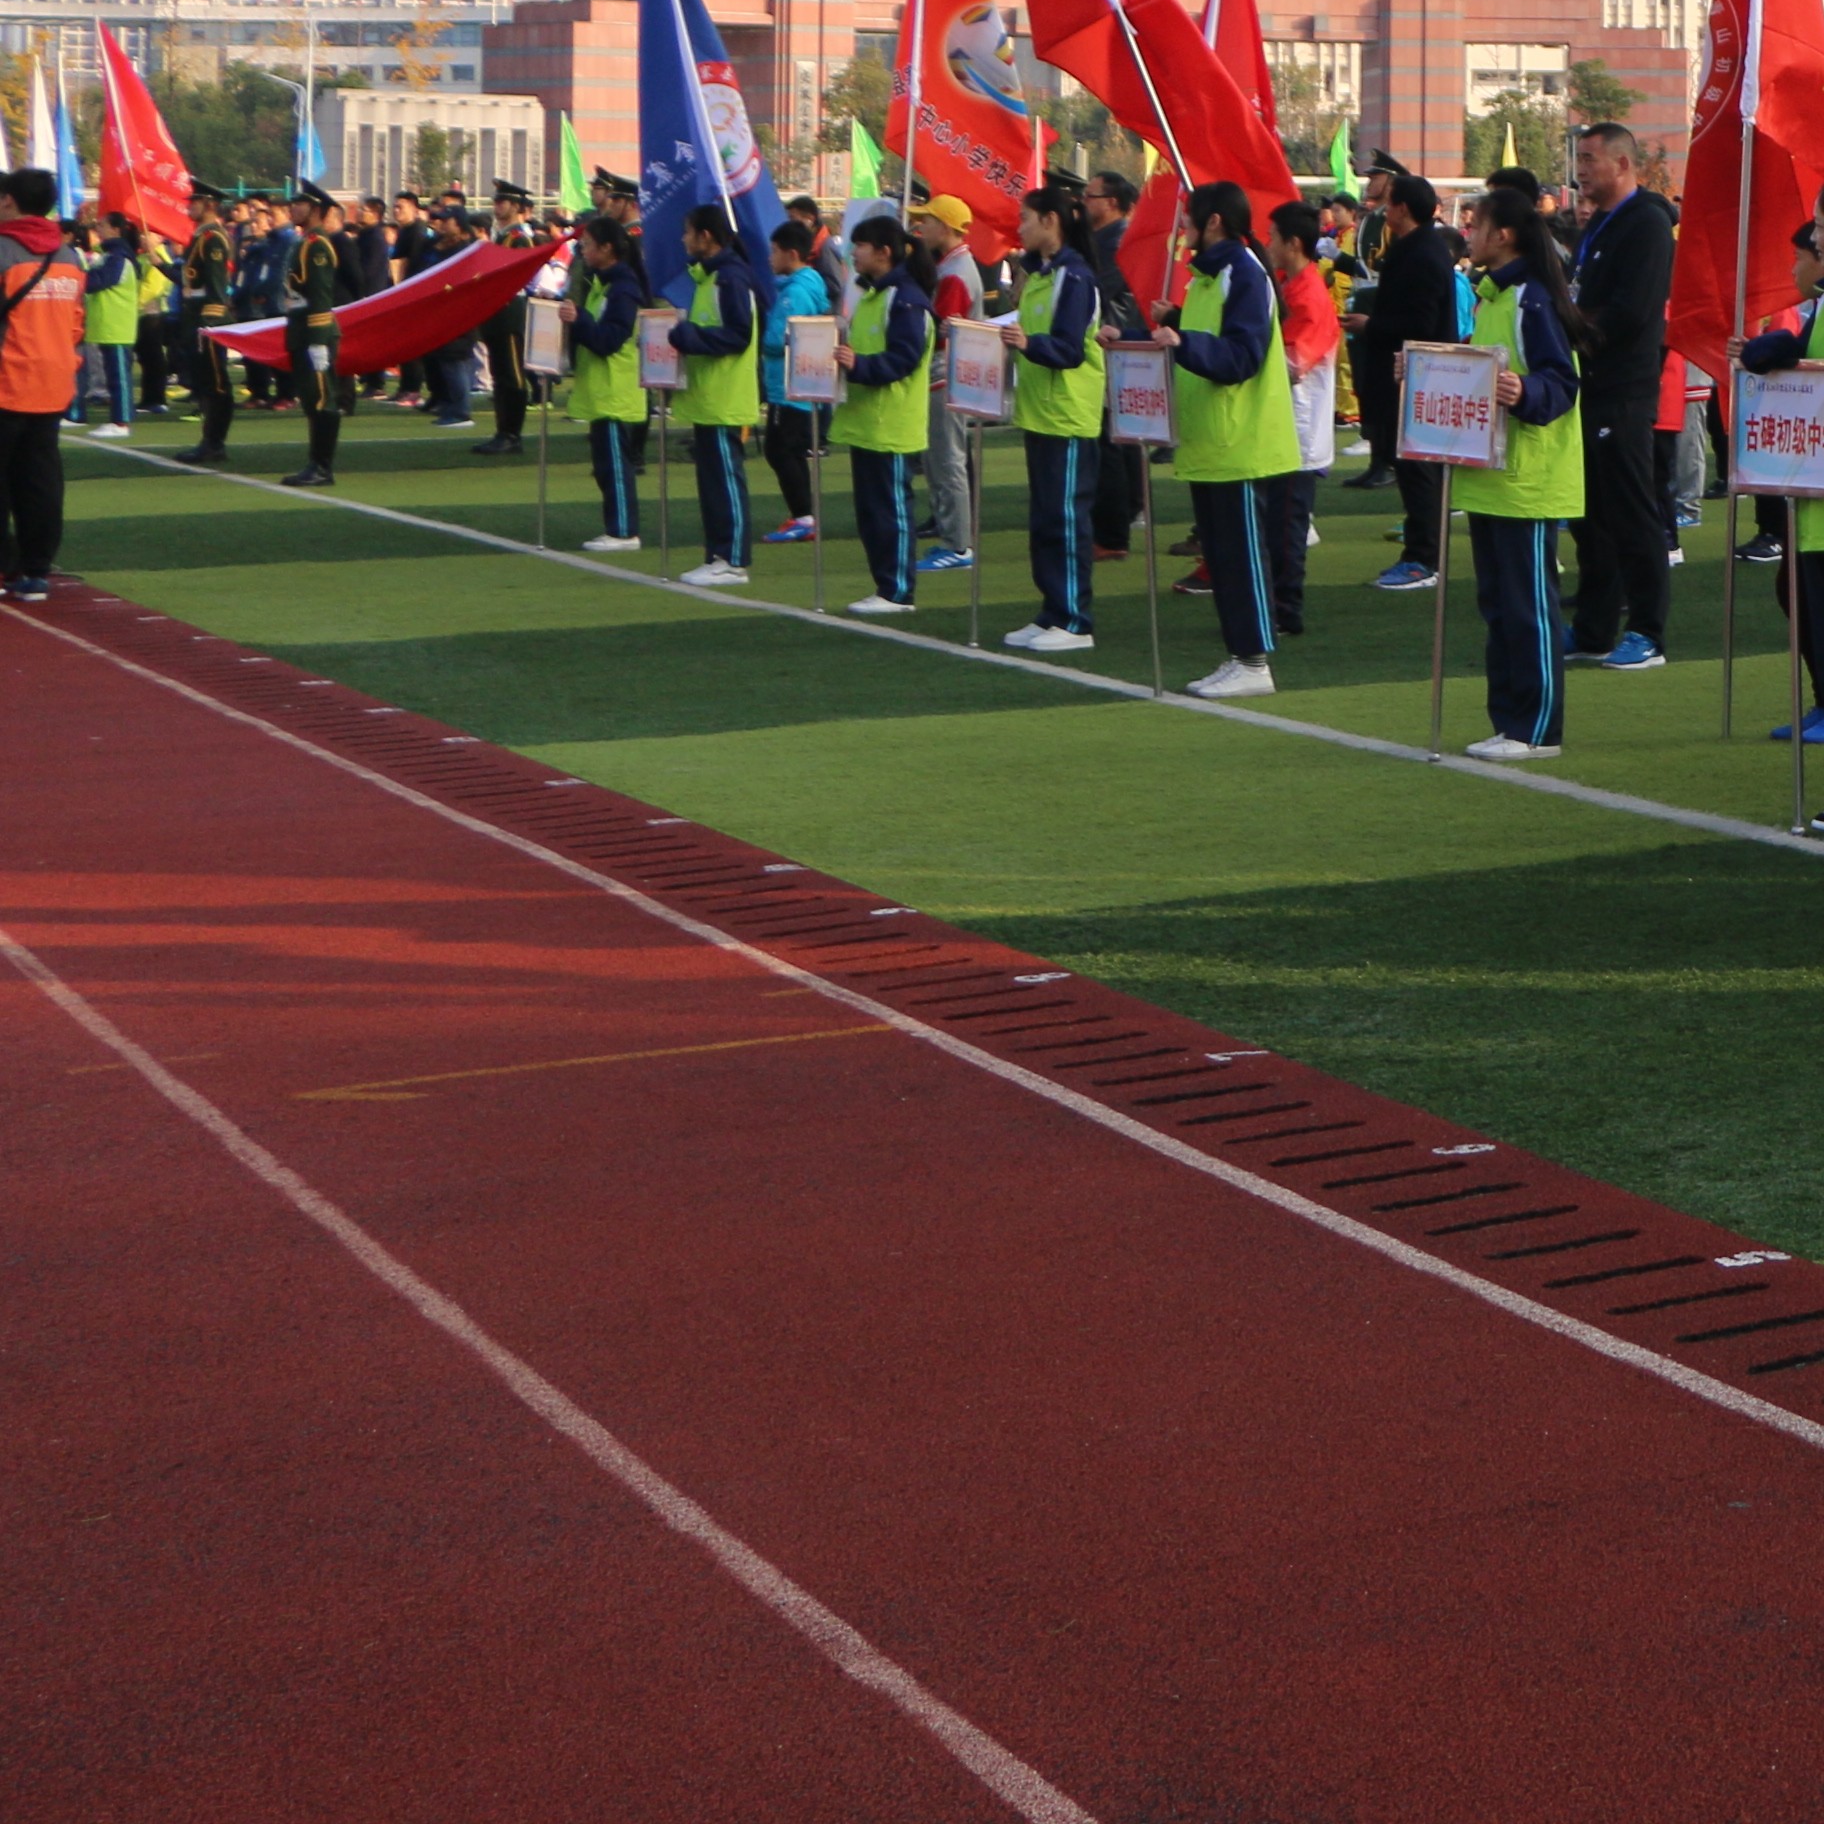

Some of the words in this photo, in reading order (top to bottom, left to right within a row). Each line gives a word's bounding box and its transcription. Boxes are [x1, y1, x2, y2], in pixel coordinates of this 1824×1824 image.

[1413, 389, 1489, 431] 青山初级中学
[1714, 1250, 1792, 1268] 5
